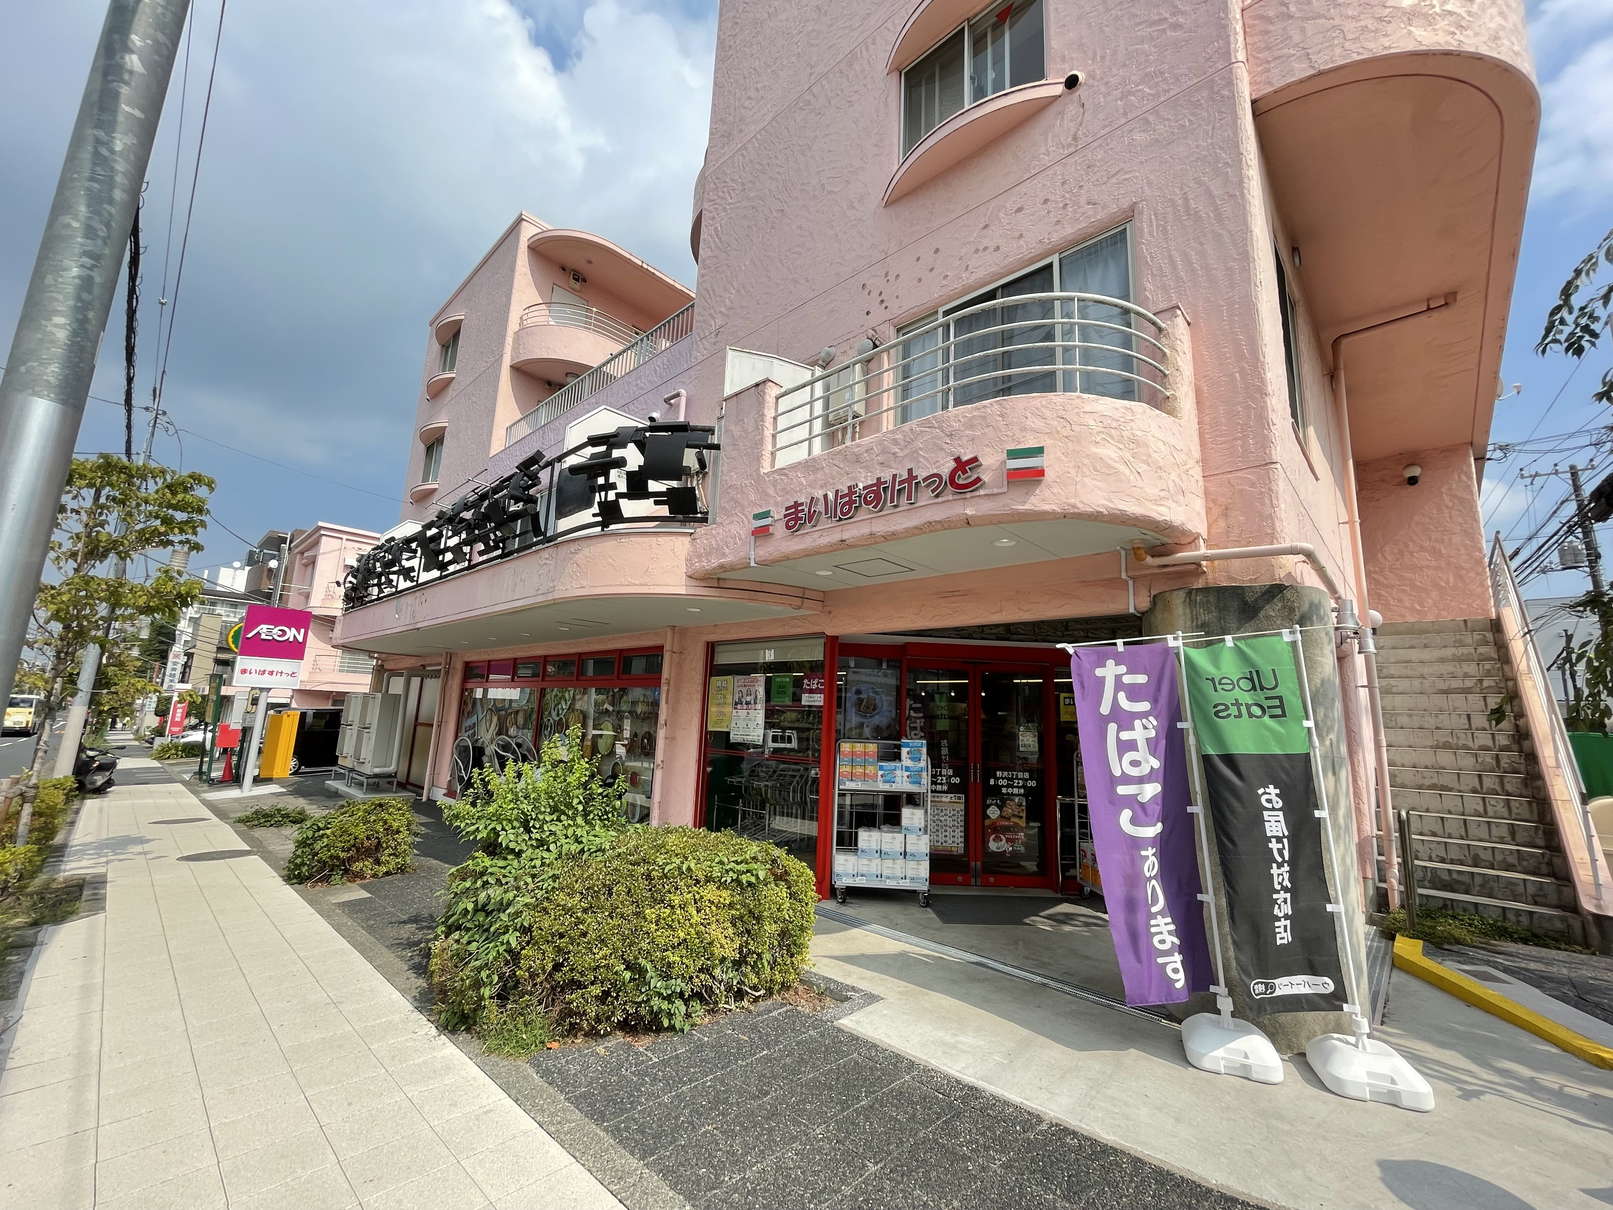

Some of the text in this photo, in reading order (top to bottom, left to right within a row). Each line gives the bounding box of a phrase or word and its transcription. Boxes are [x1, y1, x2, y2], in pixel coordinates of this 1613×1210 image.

[783, 455, 983, 532] まいばすけっと
[240, 668, 298, 678] まいばすけっと
